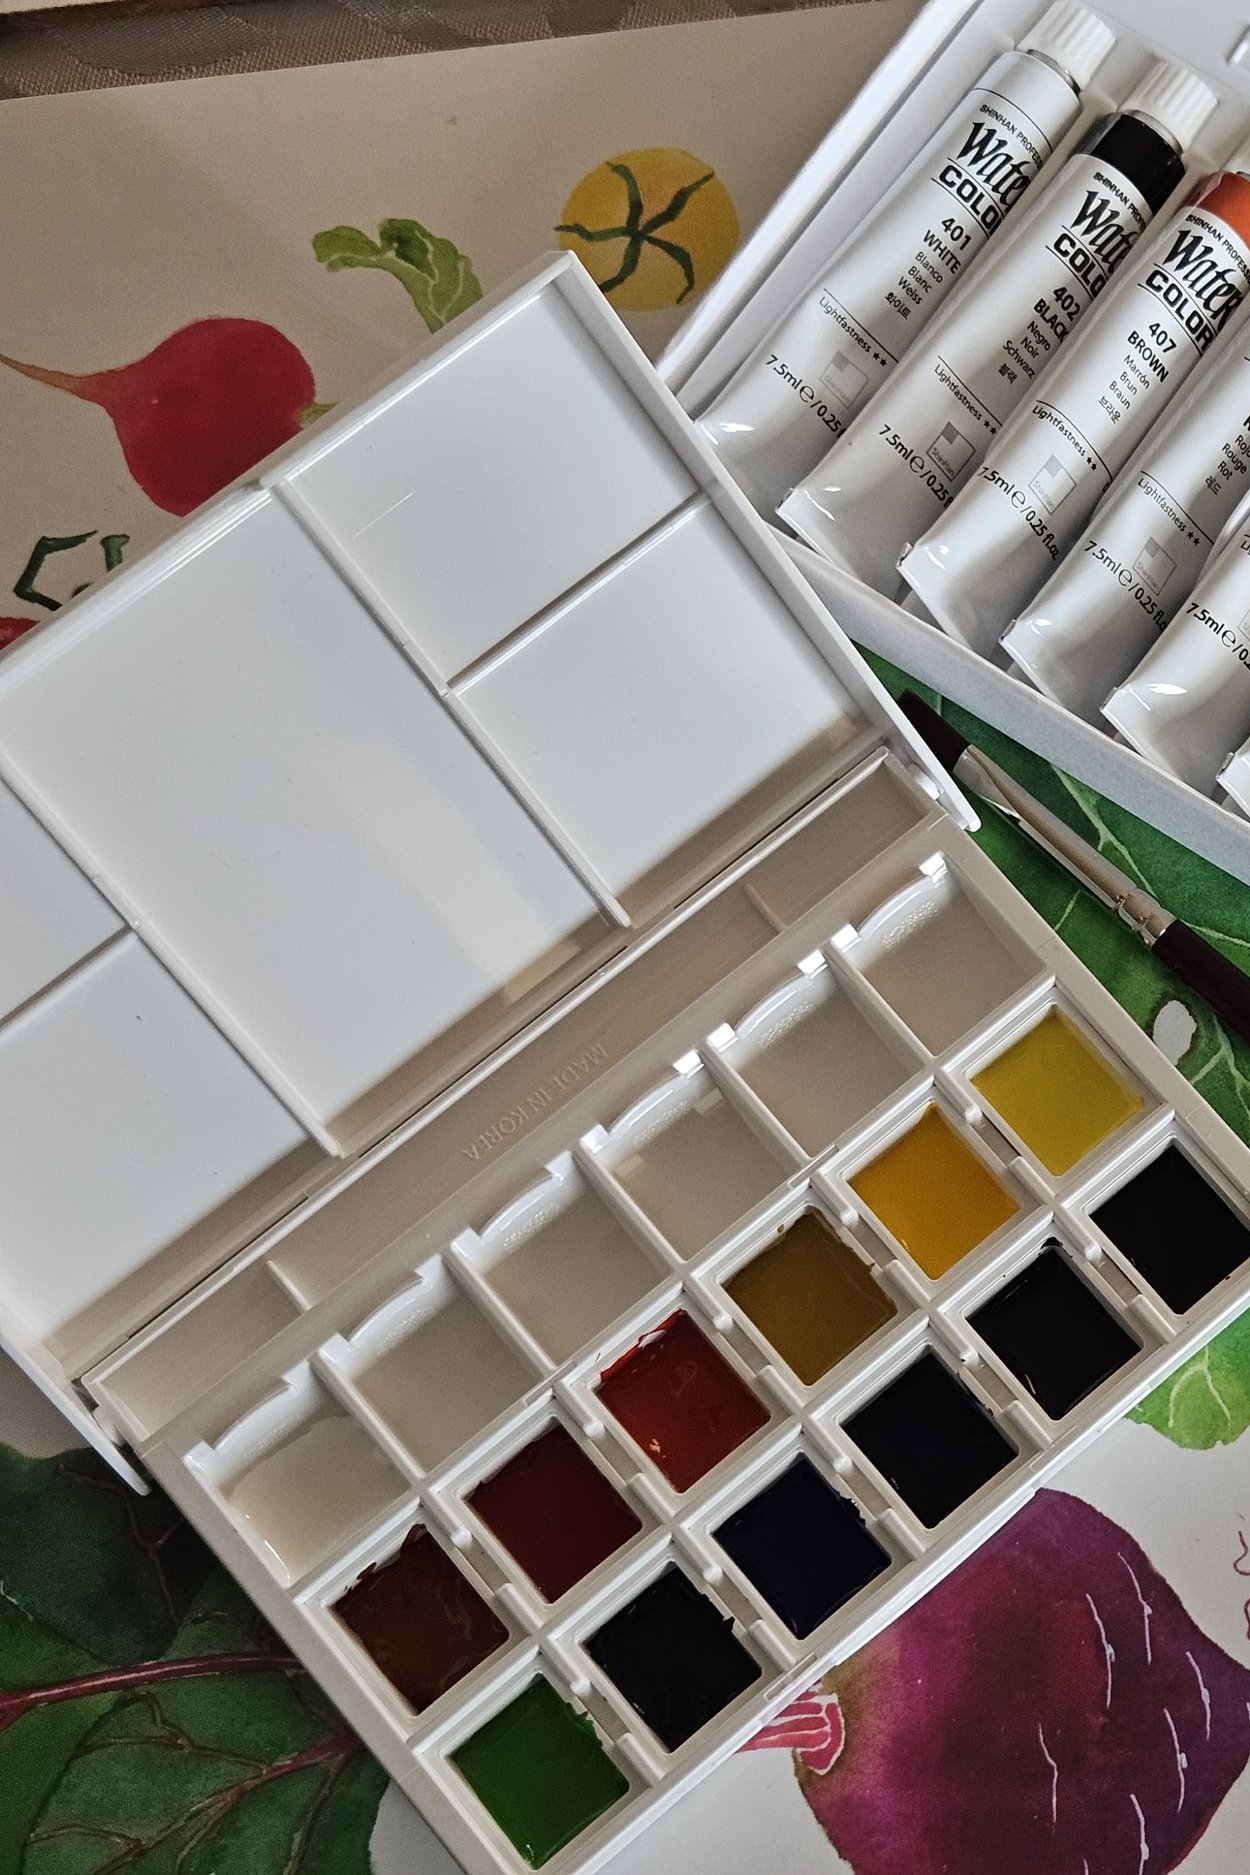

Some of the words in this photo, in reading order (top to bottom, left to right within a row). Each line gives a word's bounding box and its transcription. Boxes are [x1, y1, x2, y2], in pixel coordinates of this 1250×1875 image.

[980, 104, 1017, 137] SHINHAN
[1093, 172, 1129, 205] SHINHAN
[942, 217, 972, 251] 401
[1185, 213, 1223, 242] SHINHAN
[915, 251, 943, 283] Blanco
[923, 229, 962, 275] WHITE
[898, 276, 923, 305] Weiss
[907, 266, 932, 293] Blanc
[884, 291, 912, 319] 화이트
[1033, 298, 1071, 341] BLACK
[1053, 286, 1081, 321] 402
[818, 296, 872, 353] Lightfastness
[1026, 320, 1051, 351] Negro
[1148, 321, 1178, 353] 407
[1003, 340, 1036, 379] Schwarz
[1020, 336, 1041, 360] Noir
[1127, 330, 1170, 383] BROWN
[1119, 371, 1138, 397] Brun
[1123, 354, 1150, 389] Marrón
[933, 364, 983, 421] Lightfastness
[1108, 380, 1132, 410] Braun
[1097, 395, 1122, 424] 브라운
[1031, 404, 1087, 458] Lightfastness
[1217, 461, 1234, 481] Rot
[1221, 443, 1248, 475] Rouge
[1205, 474, 1223, 496] 레드
[1137, 477, 1187, 533] Lightfastness
